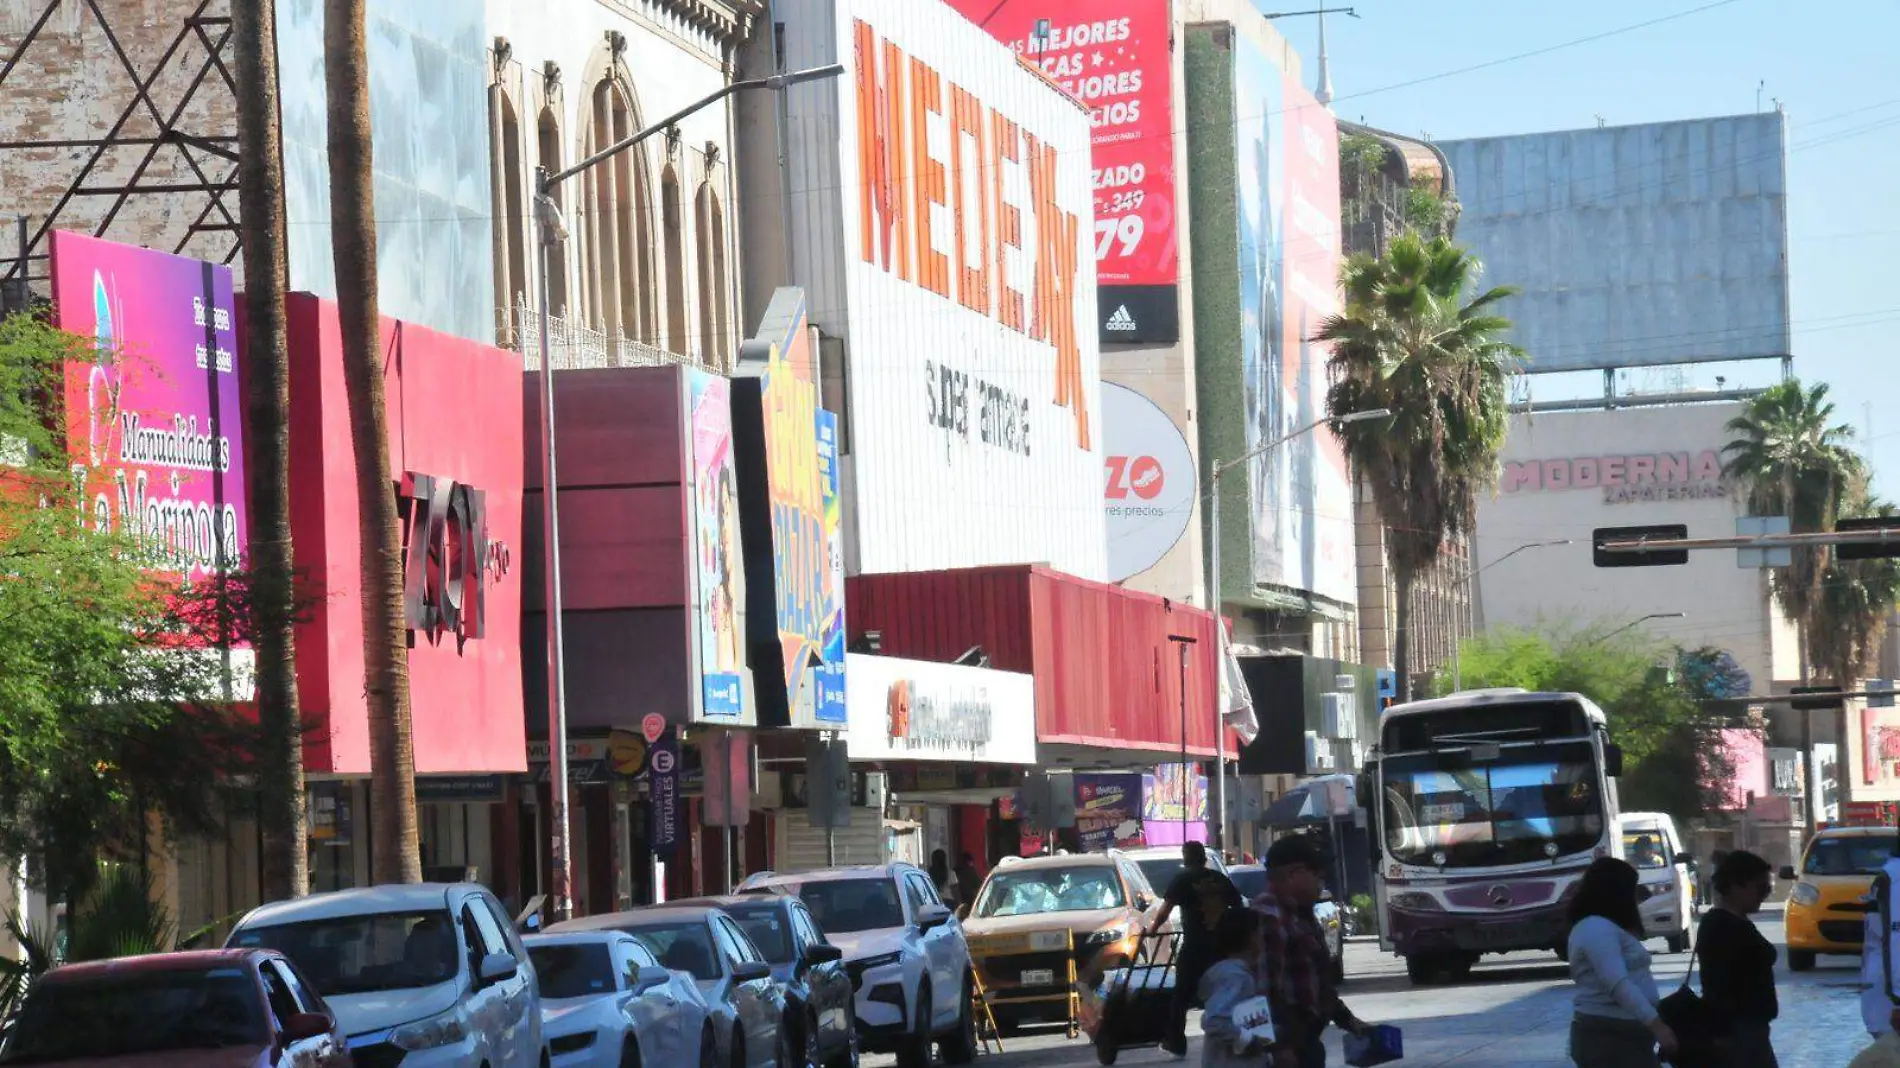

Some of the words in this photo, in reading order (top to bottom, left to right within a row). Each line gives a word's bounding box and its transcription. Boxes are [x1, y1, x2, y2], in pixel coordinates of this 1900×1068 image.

[1003, 39, 1024, 56] AS
[1032, 52, 1084, 79] CAS
[1090, 162, 1145, 190] ZADO
[1095, 214, 1144, 260] 79
[1106, 320, 1136, 331] adidas
[120, 410, 229, 473] Manualidades
[1503, 450, 1722, 493] MODERNA
[1125, 506, 1164, 519] precios
[115, 468, 240, 594] Mariposa
[664, 775, 675, 845] VIRTUALES
